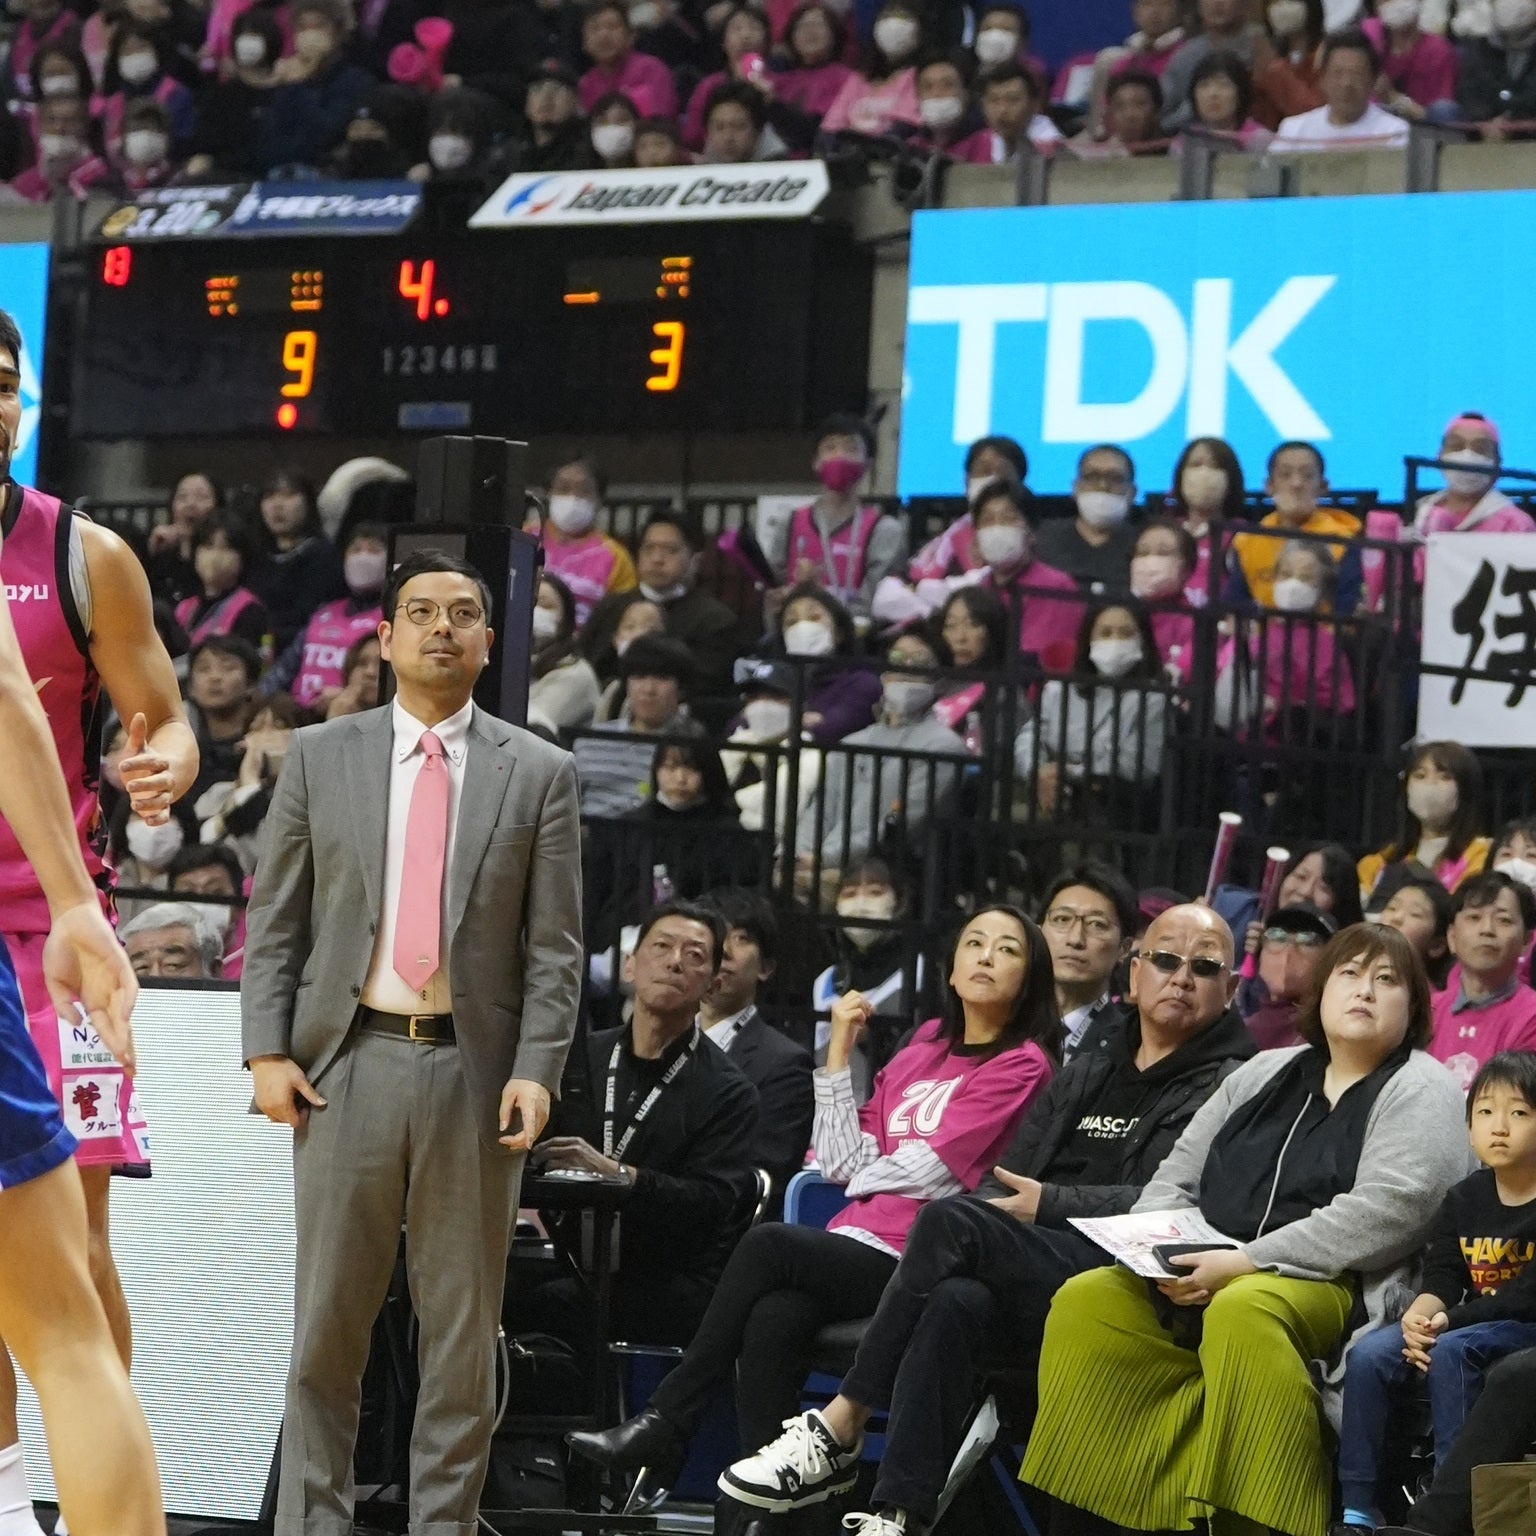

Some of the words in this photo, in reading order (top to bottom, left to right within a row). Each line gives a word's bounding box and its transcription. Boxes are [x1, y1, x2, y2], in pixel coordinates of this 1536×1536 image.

[563, 182, 680, 212] Japan
[679, 175, 809, 207] Create
[280, 330, 318, 398] 9
[645, 320, 685, 391] 3
[908, 274, 1338, 445] TDK
[887, 1073, 964, 1137] 20
